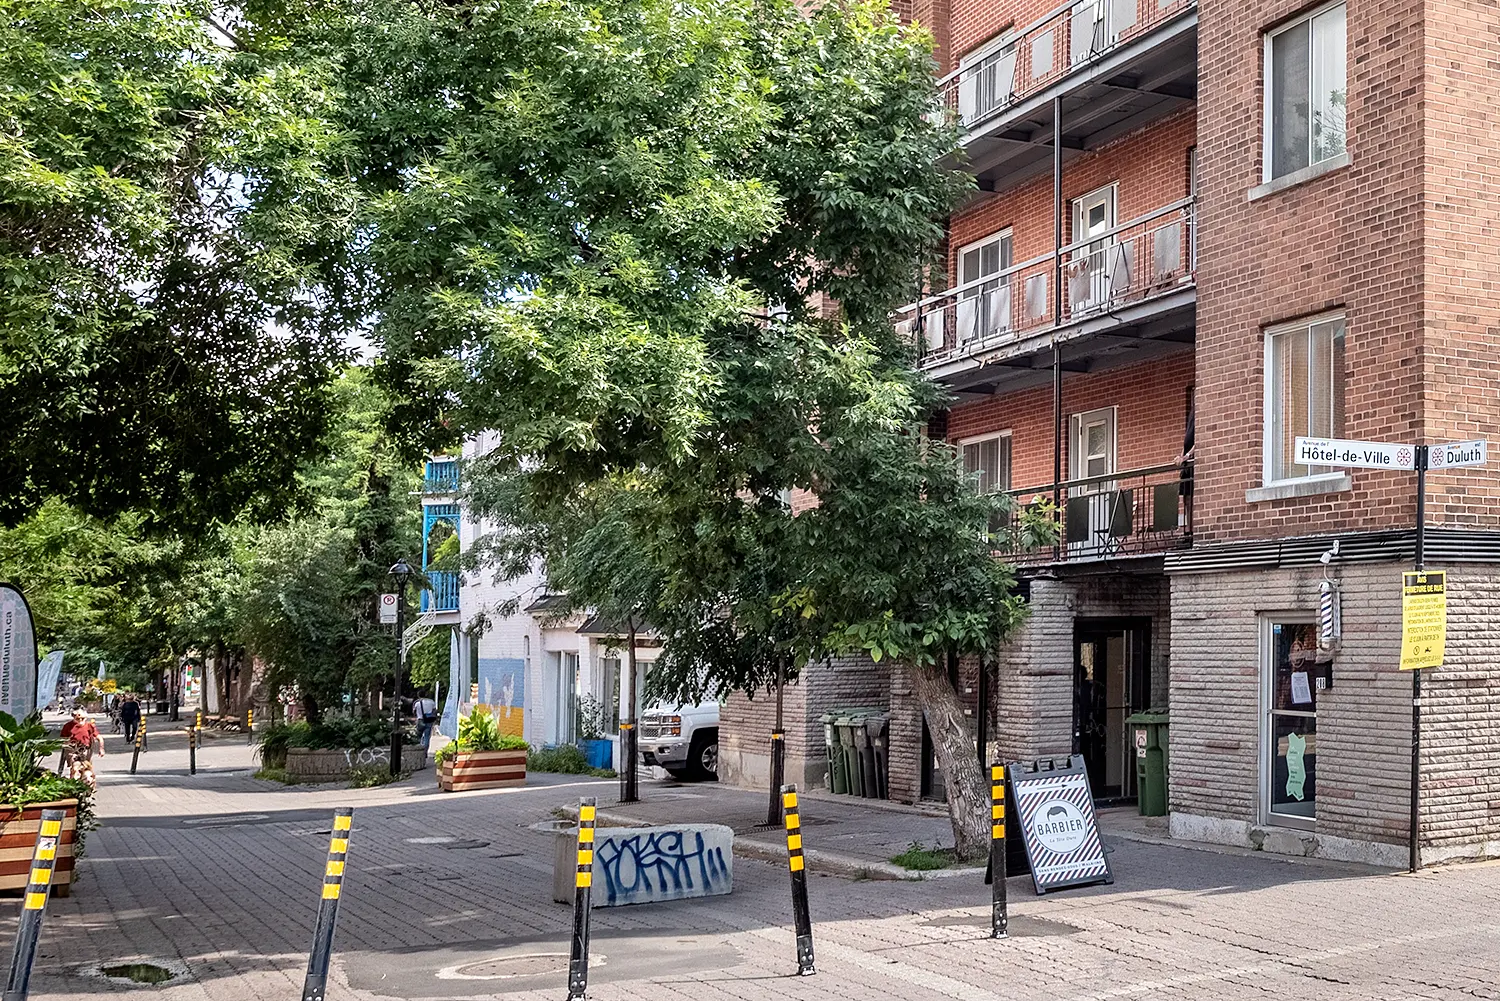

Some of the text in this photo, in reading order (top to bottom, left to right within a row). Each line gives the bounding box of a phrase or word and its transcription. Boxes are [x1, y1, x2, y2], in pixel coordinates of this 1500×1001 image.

[1301, 446, 1390, 464] Hôtel-de-Ville
[1447, 448, 1481, 464] Duluth
[1, 610, 13, 706] avenueduluth.ca
[1037, 818, 1083, 836] BARBIER
